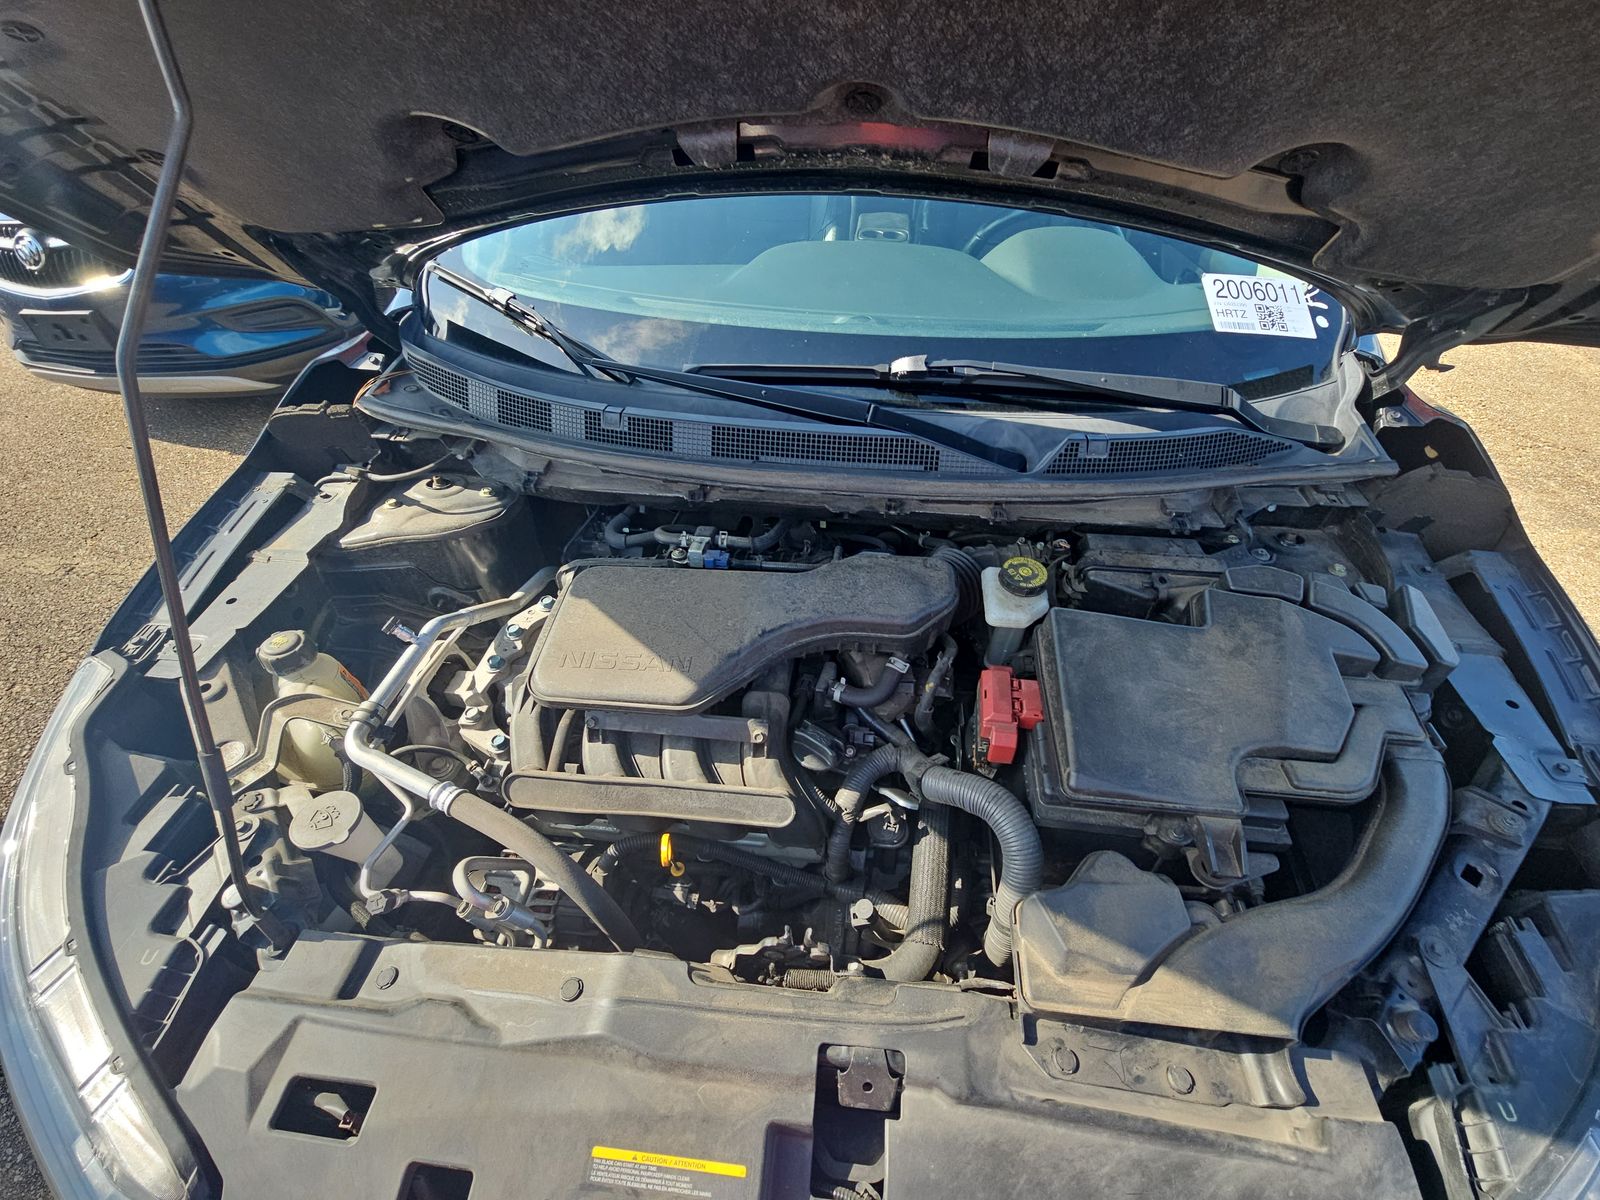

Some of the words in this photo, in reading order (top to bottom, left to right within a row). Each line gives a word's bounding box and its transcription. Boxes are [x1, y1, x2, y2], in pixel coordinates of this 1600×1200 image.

[1213, 278, 1301, 304] 2006011
[1216, 308, 1248, 319] HRTZ
[559, 651, 693, 673] NISSAN
[641, 1155, 668, 1165] CAUTION
[673, 1160, 706, 1169] ATTENTION
